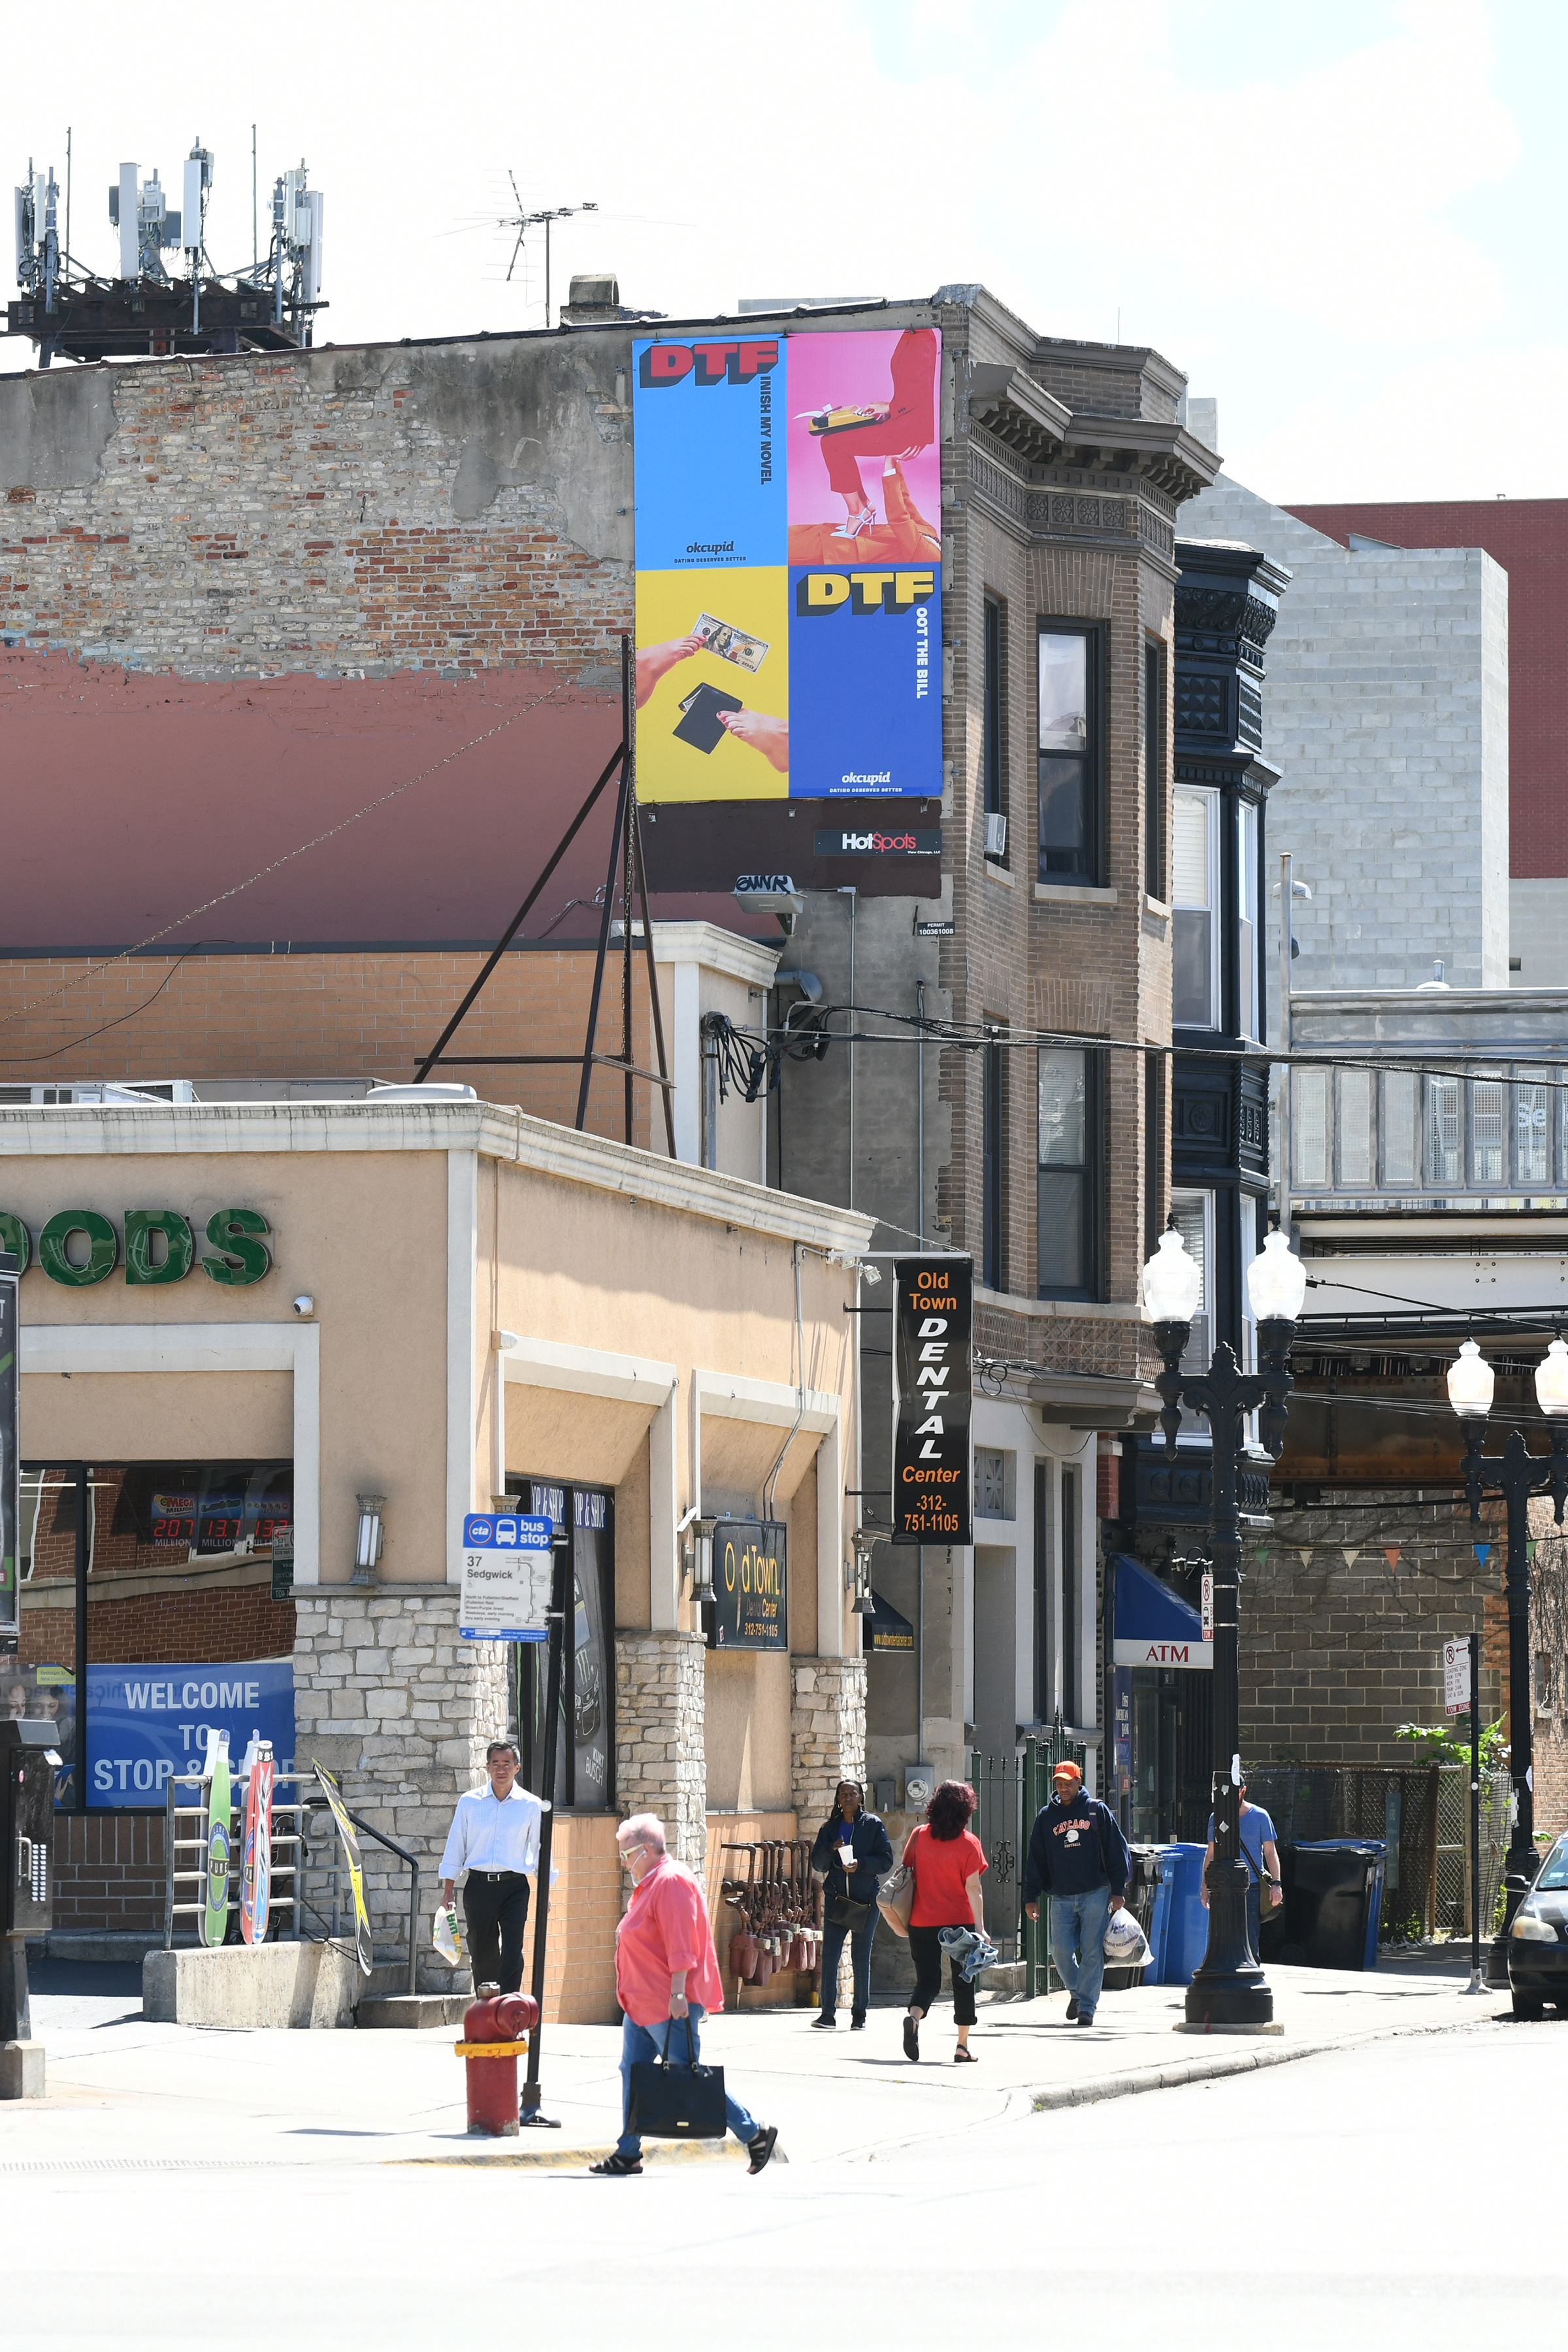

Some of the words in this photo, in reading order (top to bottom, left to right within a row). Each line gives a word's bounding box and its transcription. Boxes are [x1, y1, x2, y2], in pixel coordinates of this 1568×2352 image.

[640, 340, 779, 389] DTF
[760, 376, 772, 414] INISH
[760, 417, 772, 438] MY
[760, 441, 772, 485] NOVEL
[686, 541, 734, 555] okcupid
[796, 570, 934, 617] DTF
[916, 607, 928, 636] OOT
[916, 639, 928, 666] THE
[916, 669, 928, 698] BILL
[841, 772, 890, 786] okcupid
[841, 833, 916, 853] HotSpots
[917, 1271, 949, 1289] Old
[909, 1293, 957, 1311] Town
[915, 1318, 951, 1459] DENTAL
[902, 1465, 960, 1483] Center
[167, 1497, 194, 1507] MEGA
[591, 1494, 606, 1528] SHOP
[916, 1495, 947, 1511] -312-
[154, 1519, 195, 1537] 207
[208, 1520, 241, 1537] 13.7
[255, 1520, 288, 1537] 132
[472, 1526, 489, 1535] cta
[520, 1520, 544, 1532] bus
[904, 1514, 958, 1531] 751-1105
[155, 1539, 191, 1547] MILLION
[201, 1539, 238, 1547] MILLION
[520, 1533, 549, 1547] stop
[467, 1556, 482, 1567] 37
[467, 1569, 513, 1580] Sedgwick
[762, 1598, 777, 1618] Center
[744, 1622, 778, 1637] 312-751-1105
[1145, 1645, 1189, 1663] ATM
[1446, 1666, 1458, 1674] LOADING
[124, 1682, 260, 1709] WELCOME
[1458, 1702, 1471, 1711] ZONE
[178, 1724, 212, 1752] TO
[593, 1746, 604, 1765] KURT
[94, 1759, 174, 1790] STOP
[585, 1756, 604, 1787] BUSCH
[210, 1860, 228, 1874] PURE
